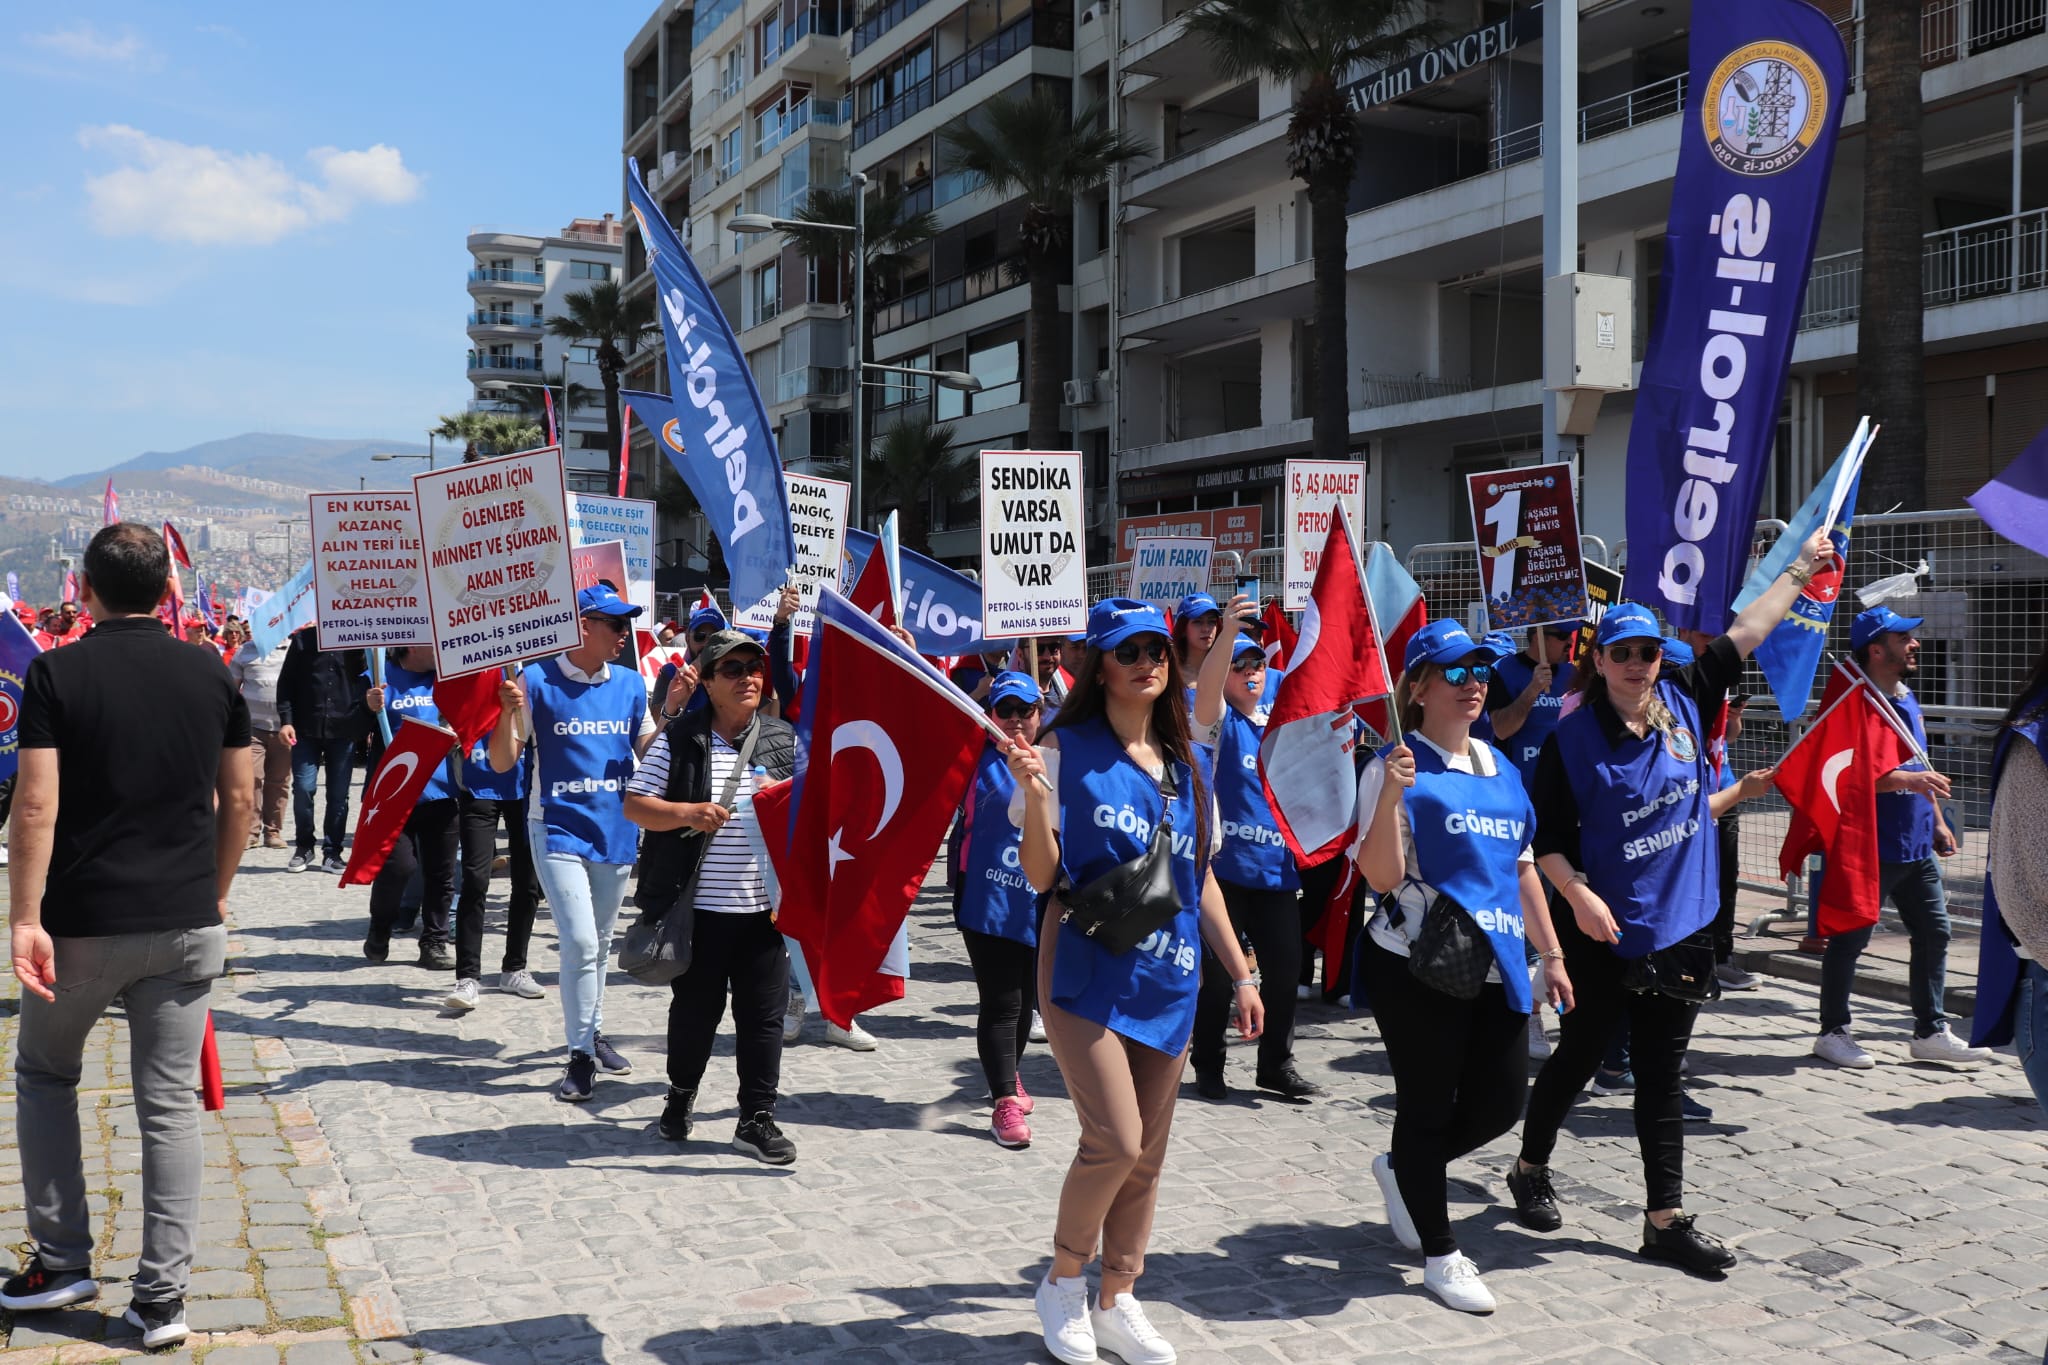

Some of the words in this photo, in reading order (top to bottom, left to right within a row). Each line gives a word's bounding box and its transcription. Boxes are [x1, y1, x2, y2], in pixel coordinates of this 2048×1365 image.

[446, 472, 502, 500] HAKLARI
[506, 464, 533, 491] İÇİN
[991, 461, 1071, 490] SENDİKA
[1292, 466, 1304, 500] İŞ,
[1306, 473, 1320, 500] AŞ
[1322, 472, 1360, 495] ADALET
[791, 483, 827, 499] DAHA
[327, 501, 348, 513] EN
[353, 500, 411, 512] KUTSAL
[462, 500, 526, 529] ÖLENLERE
[575, 503, 608, 516] ÖZGÜR
[611, 506, 623, 517] VE
[626, 508, 644, 519] EŞİT
[1001, 499, 1062, 522] VARSA
[339, 520, 402, 533] KAZANÇ
[569, 518, 584, 528] BİR
[587, 521, 626, 533] GELECEK
[629, 522, 649, 536] İÇİN
[322, 540, 358, 552] ALIN
[363, 536, 394, 551] TERİ
[400, 536, 420, 550] İLE
[432, 540, 482, 569] MİNNET
[486, 536, 501, 556] VE
[506, 525, 561, 556] ŞÜKRAN,
[990, 532, 1043, 556] UMUT
[1050, 531, 1076, 554] DA
[327, 558, 417, 572] KAZANILAN
[1140, 544, 1165, 567] TÜM
[1169, 549, 1207, 567] FARKI
[467, 567, 503, 592] AKAN
[506, 561, 535, 583] TERE
[794, 564, 836, 579] LASTİK
[1015, 563, 1052, 587] VAR
[351, 578, 397, 590] HELAL
[1140, 581, 1197, 600] YARATAN
[332, 596, 418, 611] KAZANÇTIR
[448, 604, 486, 628] SAYGI
[489, 598, 505, 617] VE
[510, 589, 561, 614] SELAM...
[988, 600, 1032, 613] PETROL-İŞ
[1035, 597, 1083, 610] SENDİKASI
[322, 616, 373, 629] PETROL-İŞ
[376, 614, 429, 626] SENDİKASI
[441, 625, 505, 650] PETROL-İŞ
[508, 611, 573, 635] SENDİKASI
[1001, 617, 1037, 629] MANİSA
[1040, 614, 1071, 630] ŞUBESİ
[338, 630, 378, 642] MANİSA
[381, 629, 416, 642] ŞUBESİ
[462, 644, 512, 665] MANİSA
[516, 631, 558, 655] ŞUBESİ
[392, 696, 433, 710] GÖRE
[554, 718, 632, 735] GÖREVLİ
[552, 776, 630, 796] petrol-i
[1093, 804, 1195, 860] GÖRVL
[1445, 809, 1525, 841] GÖREV
[986, 868, 1023, 888] GÜÇLÜ
